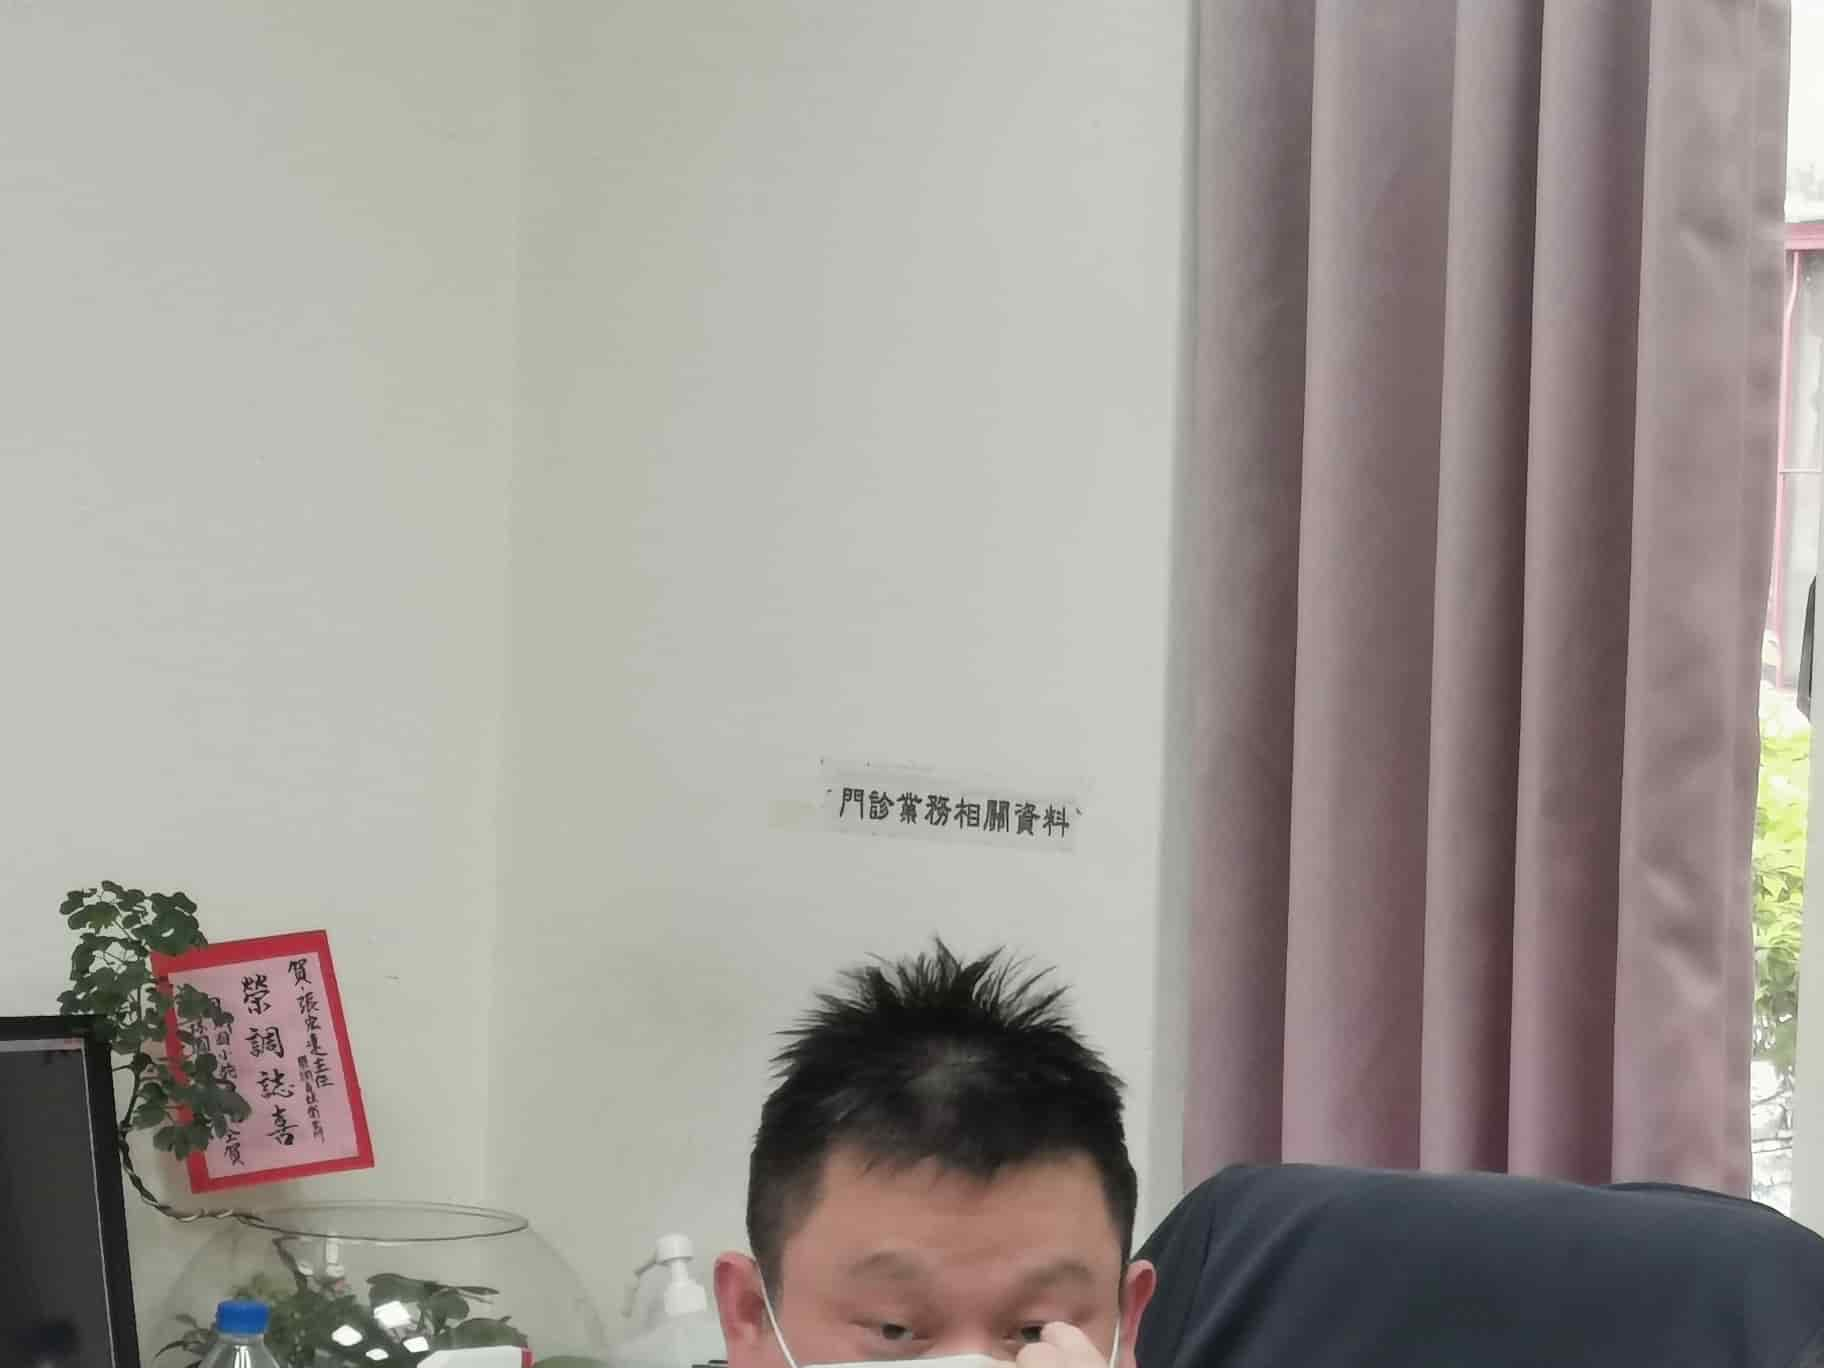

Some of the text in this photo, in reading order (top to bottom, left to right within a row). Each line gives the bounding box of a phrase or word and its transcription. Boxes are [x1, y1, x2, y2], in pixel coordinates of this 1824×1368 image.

[839, 787, 1070, 837] 門診業務相關資料
